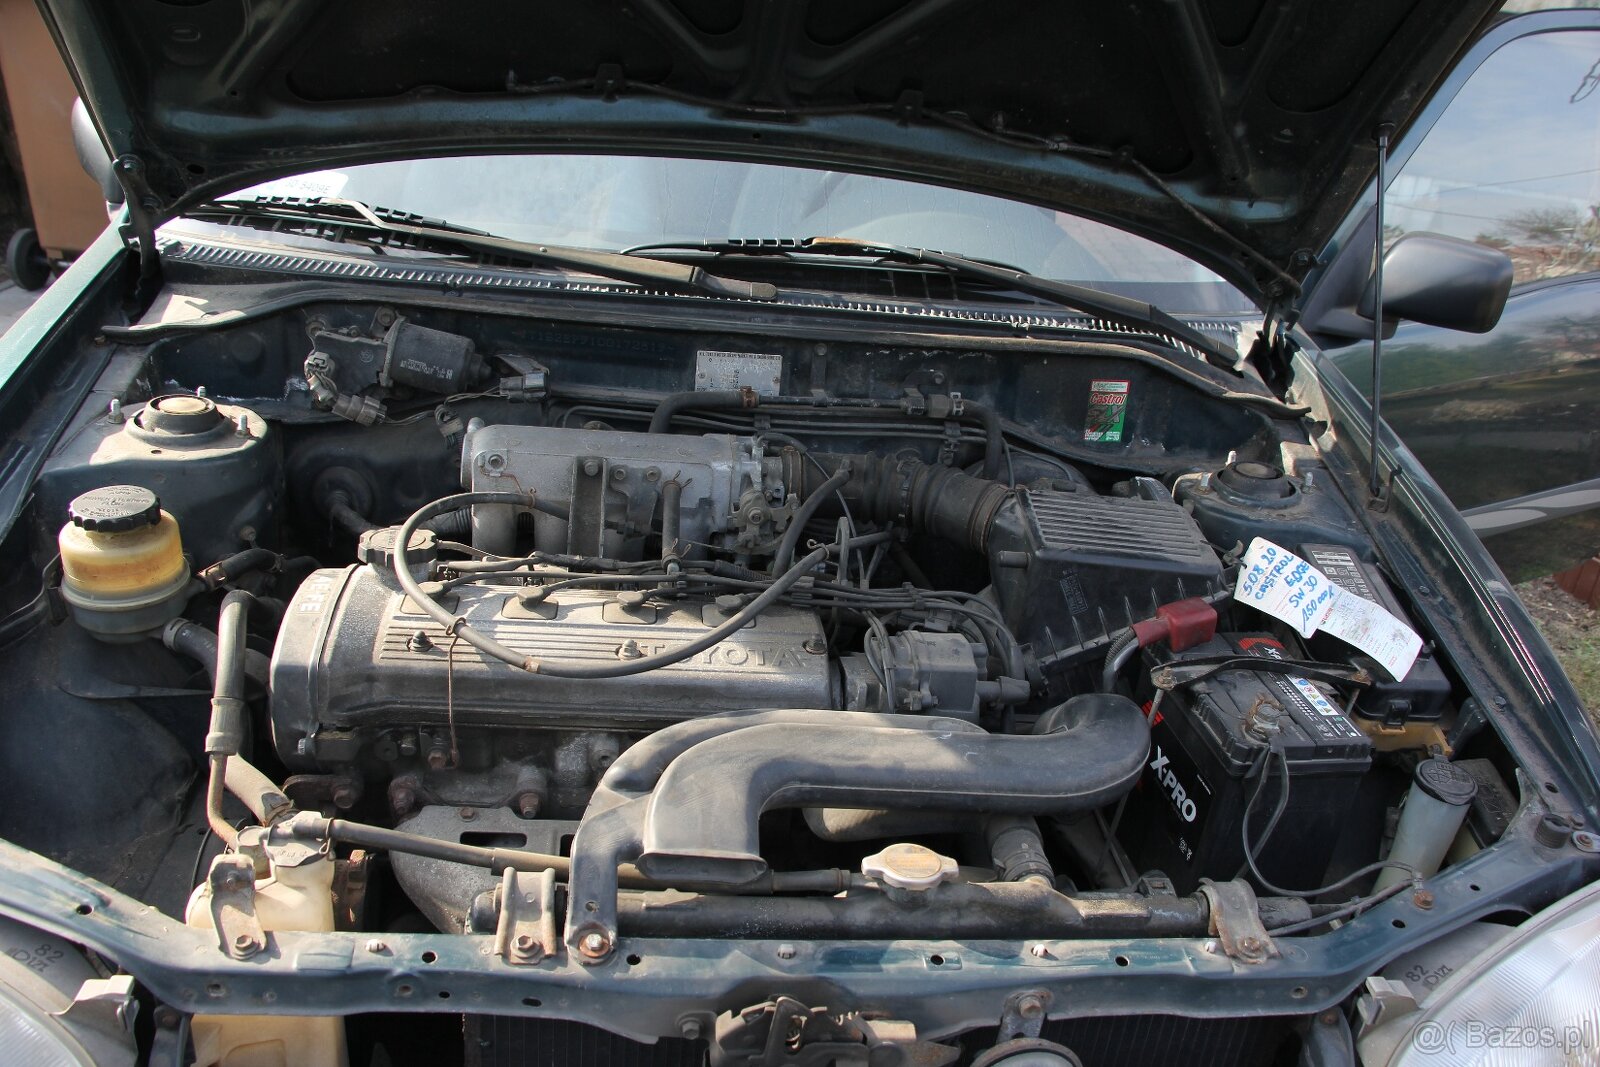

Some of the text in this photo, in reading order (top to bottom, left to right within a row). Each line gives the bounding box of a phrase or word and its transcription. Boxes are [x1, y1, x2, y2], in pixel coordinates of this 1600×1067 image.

[1090, 392, 1127, 406] Castrol
[1255, 555, 1295, 600] CASTROL
[1283, 560, 1310, 588] EDGE
[1149, 745, 1197, 823] X-PRO
[34, 943, 65, 964] 82
[1404, 964, 1429, 983] 82
